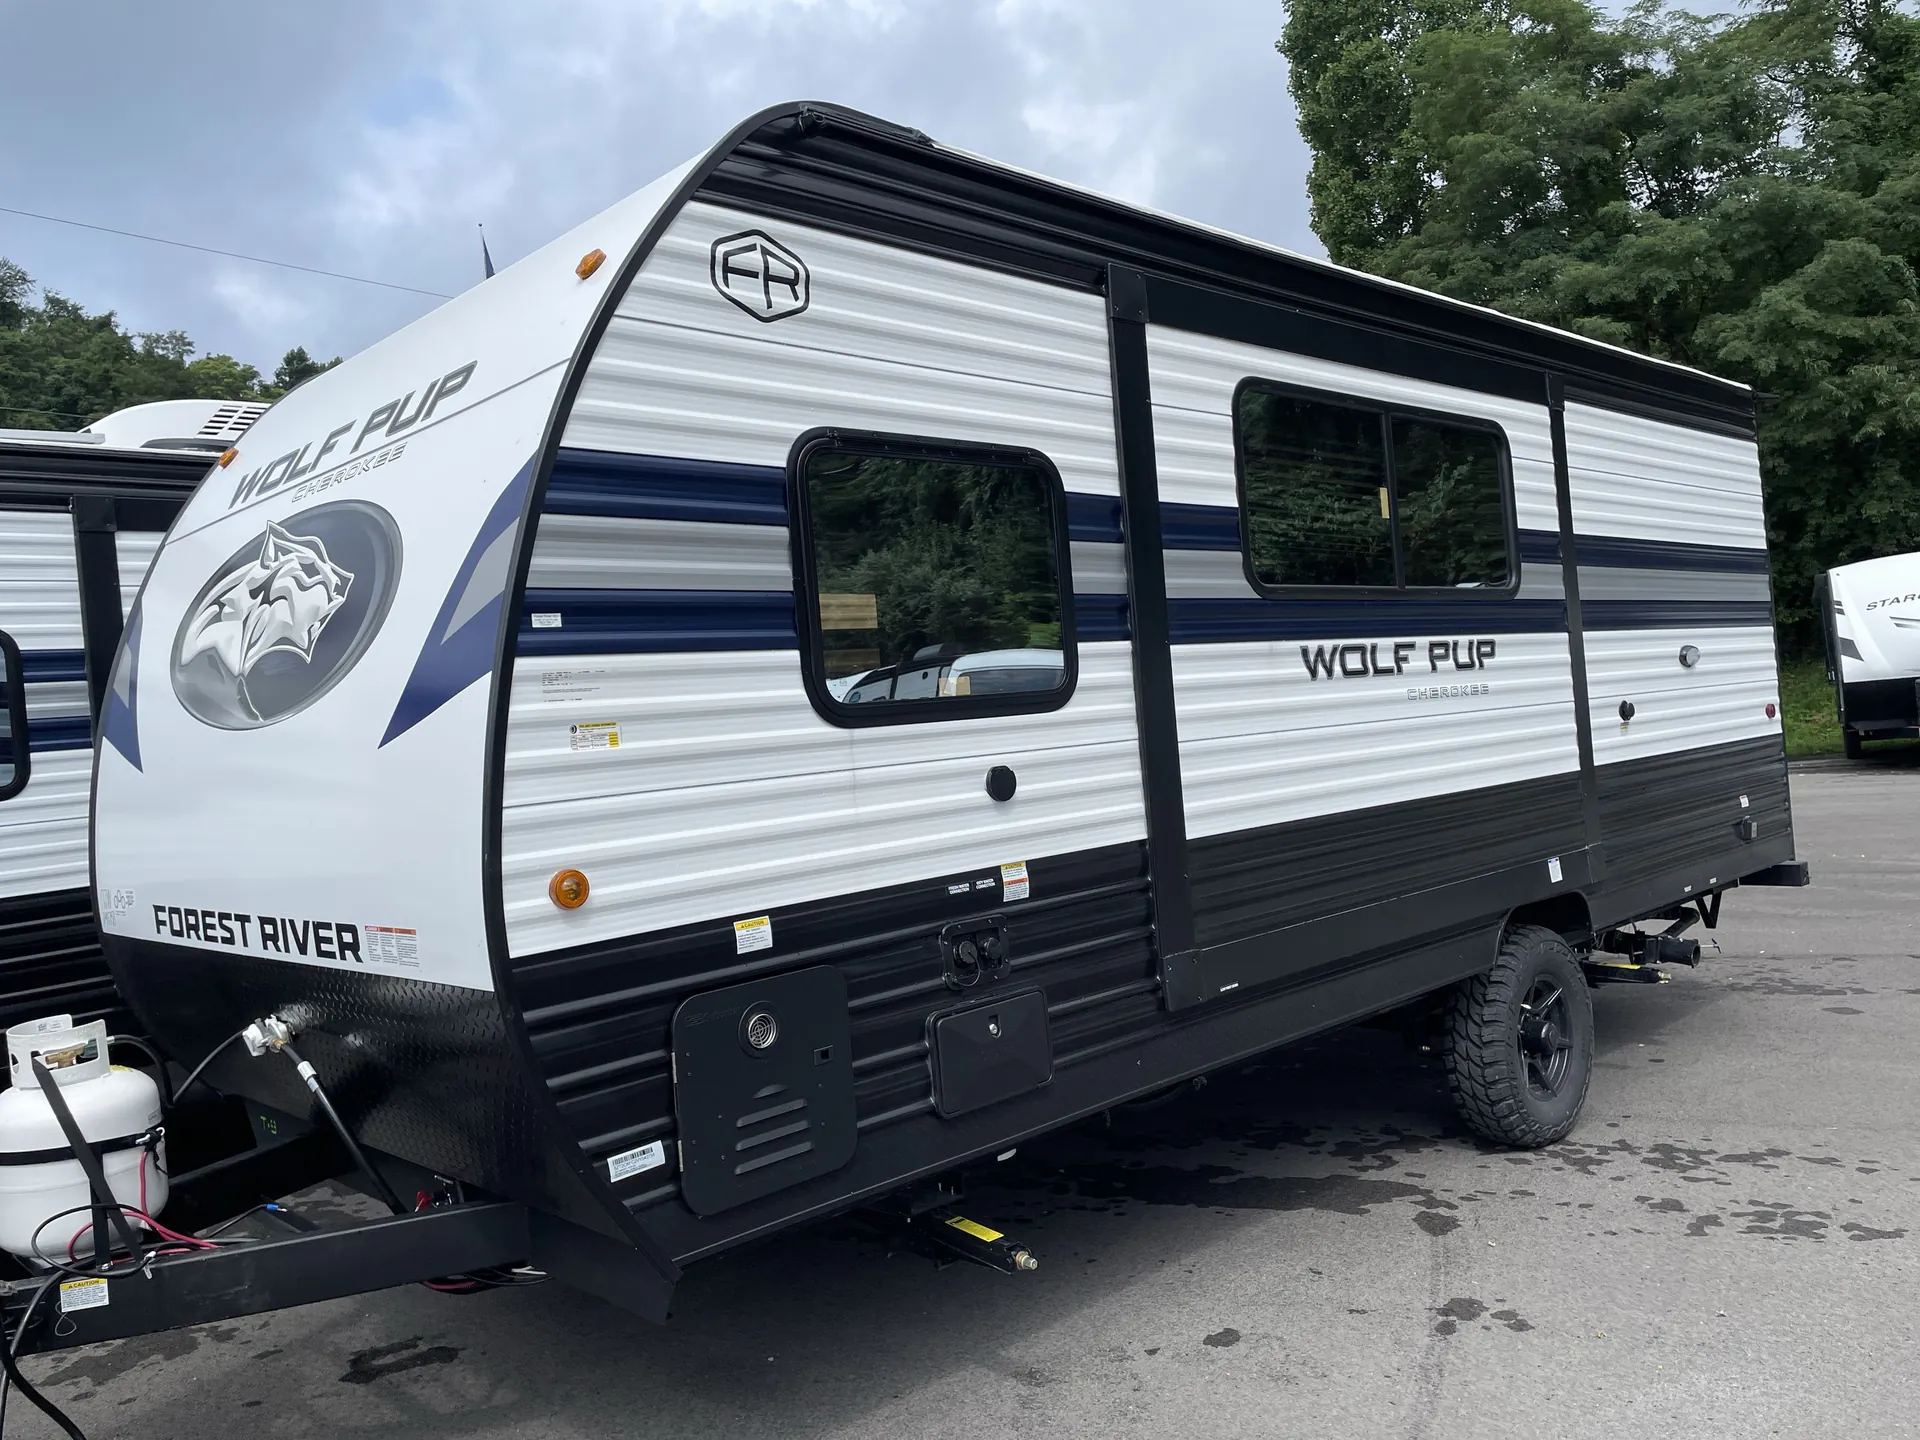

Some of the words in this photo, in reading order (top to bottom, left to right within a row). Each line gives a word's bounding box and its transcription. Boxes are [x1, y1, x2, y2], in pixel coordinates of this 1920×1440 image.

[228, 420, 357, 510] WOLF
[350, 360, 478, 455] PUP
[292, 442, 408, 503] CHEROKEE
[1866, 593, 1920, 611] STAR
[1299, 641, 1417, 682] WOLF
[1428, 638, 1497, 673] PUP
[1406, 683, 1490, 700] CHEROKEE
[152, 904, 251, 948] FOREST
[256, 915, 363, 963] RIVER
[744, 920, 765, 928] CAUTION
[73, 1280, 100, 1288] CAUTION
